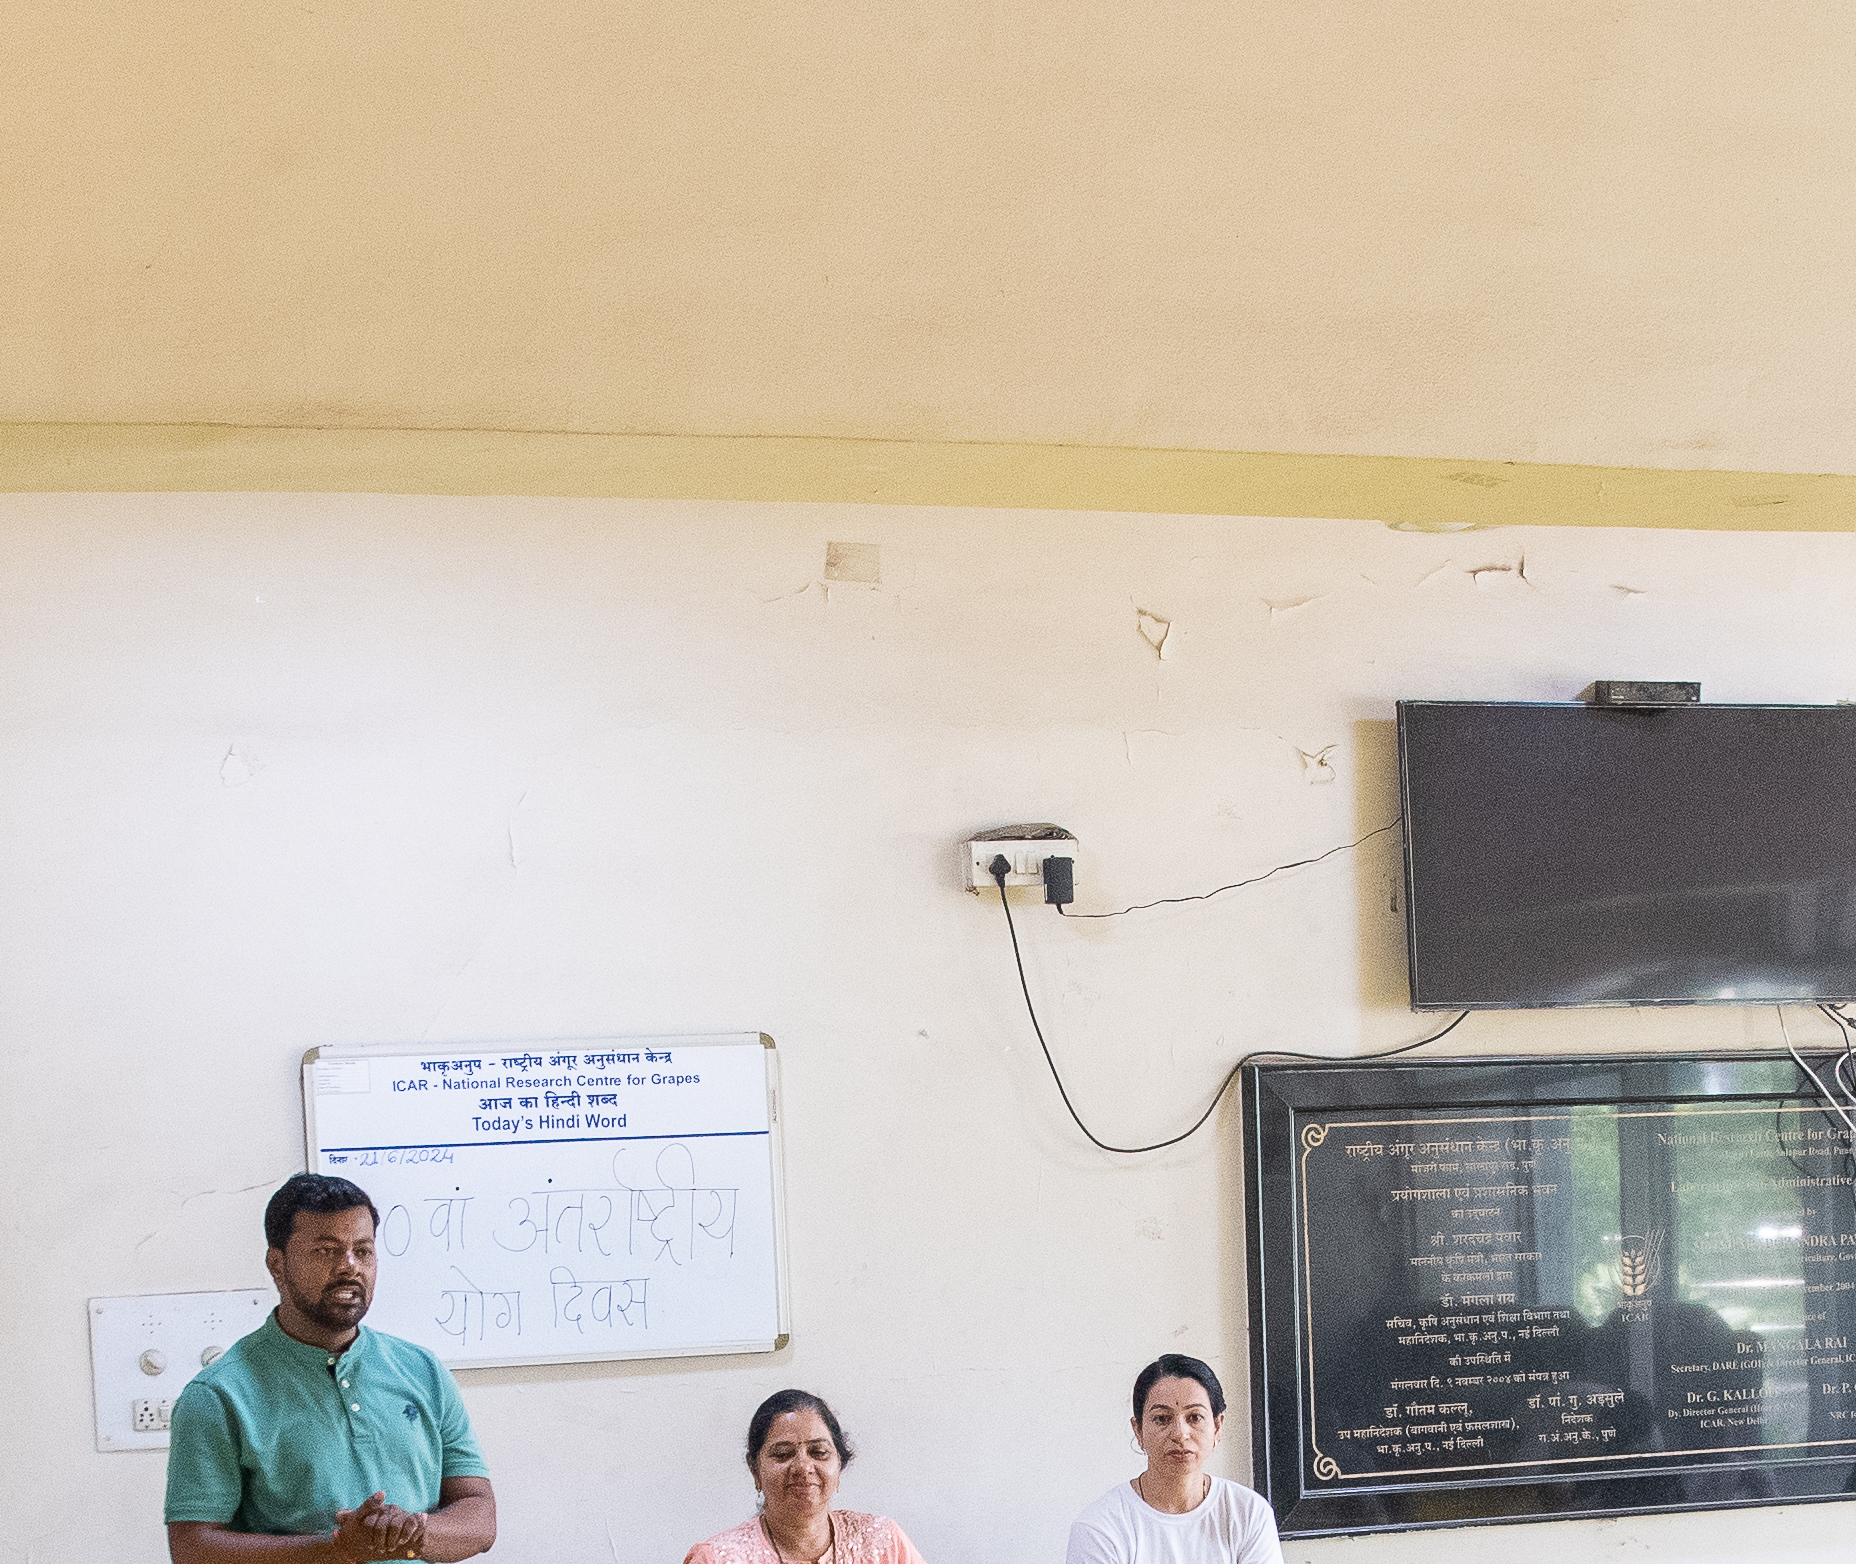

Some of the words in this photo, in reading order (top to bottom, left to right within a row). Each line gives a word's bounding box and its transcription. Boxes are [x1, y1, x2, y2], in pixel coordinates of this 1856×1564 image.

[420, 1059, 482, 1076] भाकृअनुप
[501, 1053, 542, 1072] राष्ट्रीय
[548, 1050, 577, 1070] अंगूर
[584, 1049, 640, 1069] अनुसंधान
[644, 1047, 672, 1064] केन्द्र
[393, 1080, 428, 1092] ICAR
[443, 1077, 501, 1090] National
[506, 1075, 572, 1088] Research
[576, 1075, 621, 1087] Centre
[627, 1074, 646, 1085] for
[651, 1073, 700, 1087] Grapes
[478, 1097, 513, 1110] आज
[519, 1096, 539, 1109] का
[545, 1091, 581, 1108] हिन्दी
[586, 1094, 618, 1108] शब्द
[472, 1115, 534, 1133] Today's
[540, 1115, 580, 1129] Hindi
[585, 1113, 627, 1128] Word
[1657, 1132, 1707, 1146] National
[1766, 1128, 1806, 1143] Centre
[1808, 1127, 1824, 1140] for
[1345, 1141, 1383, 1161] राष्ट्रीय
[1389, 1139, 1415, 1159] अंगूर
[1419, 1137, 1472, 1159] अनुसंधान
[1771, 1175, 1852, 1190] Administrative
[1391, 1187, 1450, 1202] प्रयोगशाला
[1454, 1183, 1470, 1201] एवं
[435, 1265, 521, 1346] योग
[550, 1266, 651, 1334] दिवस
[1440, 1293, 1458, 1308] डॉ.
[1462, 1292, 1494, 1307] मंगला
[1497, 1292, 1516, 1303] राय
[1386, 1316, 1416, 1330] सचिव,
[1418, 1316, 1438, 1331] कृषि
[1440, 1313, 1480, 1329] अनुसंधान
[1482, 1311, 1496, 1327] एवं
[1498, 1311, 1521, 1324] शिक्षा
[1523, 1310, 1551, 1322] विभाग
[1553, 1309, 1570, 1320] तथा
[1621, 1314, 1649, 1322] ICAR
[1397, 1333, 1452, 1347] महानिदेशक,
[1532, 1325, 1560, 1339] दिल्ली
[1737, 1341, 1754, 1354] Dr.
[1825, 1336, 1848, 1350] RAI
[1449, 1353, 1462, 1367] की
[1464, 1352, 1502, 1366] उपस्थिति
[1503, 1351, 1512, 1364] में
[1670, 1362, 1711, 1374] Secretary,
[1712, 1359, 1738, 1370] DARE
[1810, 1354, 1845, 1367] General,
[1391, 1378, 1428, 1391] मंगलवार
[1430, 1377, 1444, 1390] दि.
[1486, 1373, 1512, 1385] २००४
[1513, 1371, 1526, 1385] को
[1551, 1370, 1570, 1384] हुआ
[1822, 1382, 1840, 1395] Dr.
[1842, 1382, 1853, 1393] P.
[1527, 1394, 1545, 1409] डॉ.
[1687, 1391, 1704, 1404] Dr.
[1706, 1389, 1721, 1402] G.
[1384, 1403, 1402, 1418] डॉ.
[1405, 1401, 1436, 1416] गौतम
[1438, 1400, 1474, 1417] कल्लू,
[1682, 1406, 1715, 1418] Director
[1718, 1405, 1748, 1416] General
[1561, 1412, 1594, 1425] निदेशक
[1700, 1418, 1726, 1429] ICAR,
[1338, 1430, 1351, 1441] उप
[1353, 1425, 1402, 1440] महानिदेशक
[1405, 1422, 1447, 1438] (बागवानी
[1449, 1420, 1464, 1434] एवं
[1601, 1426, 1617, 1441] पुणे
[1456, 1437, 1484, 1450] दिल्ली
